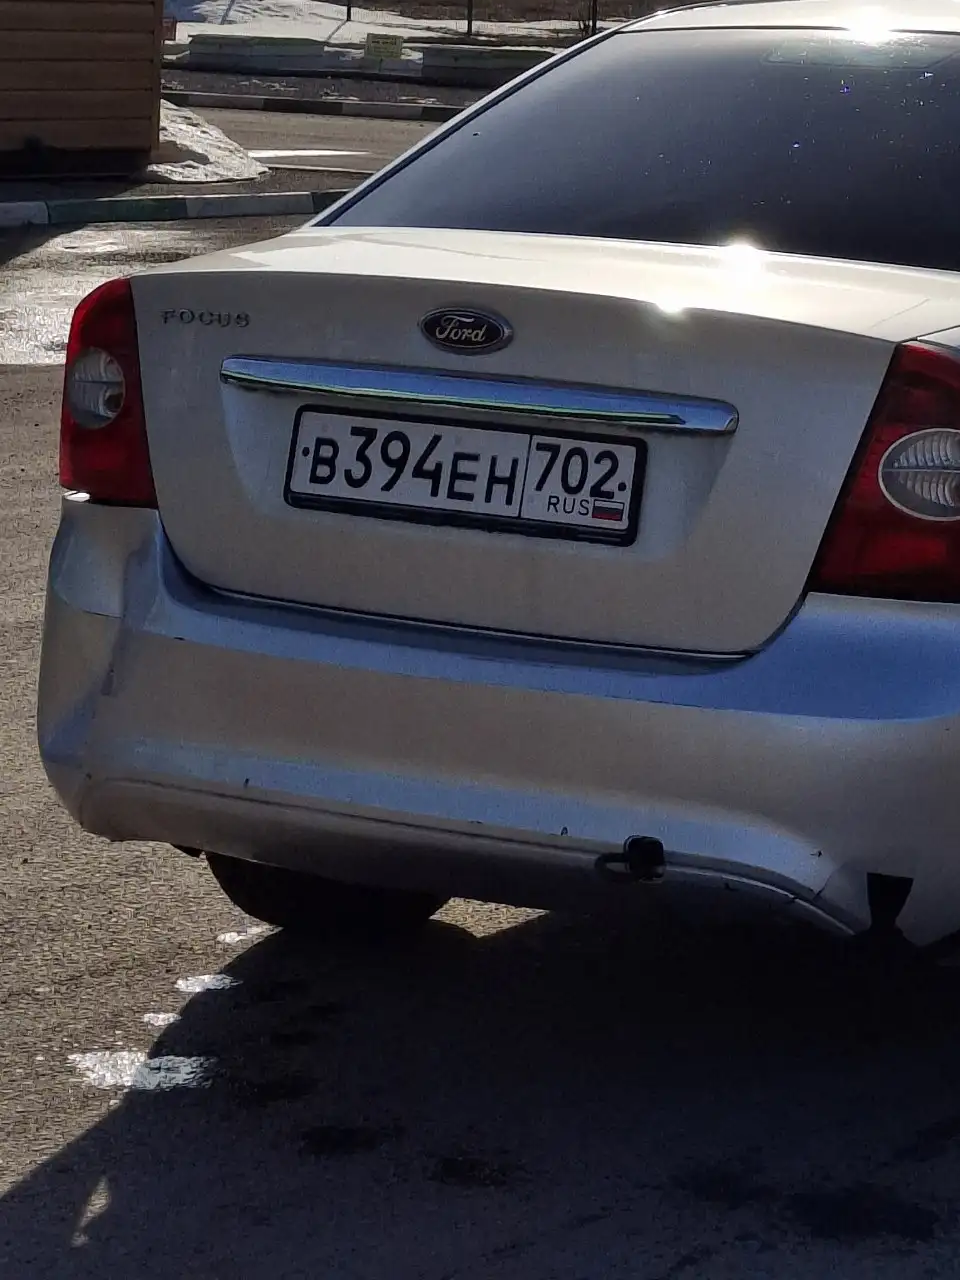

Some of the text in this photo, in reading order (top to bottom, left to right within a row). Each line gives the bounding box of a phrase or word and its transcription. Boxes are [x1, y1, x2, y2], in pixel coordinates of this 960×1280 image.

[160, 309, 250, 327] FOCUS
[436, 316, 487, 341] Ford
[534, 443, 619, 499] 702
[547, 495, 590, 516] RUS
